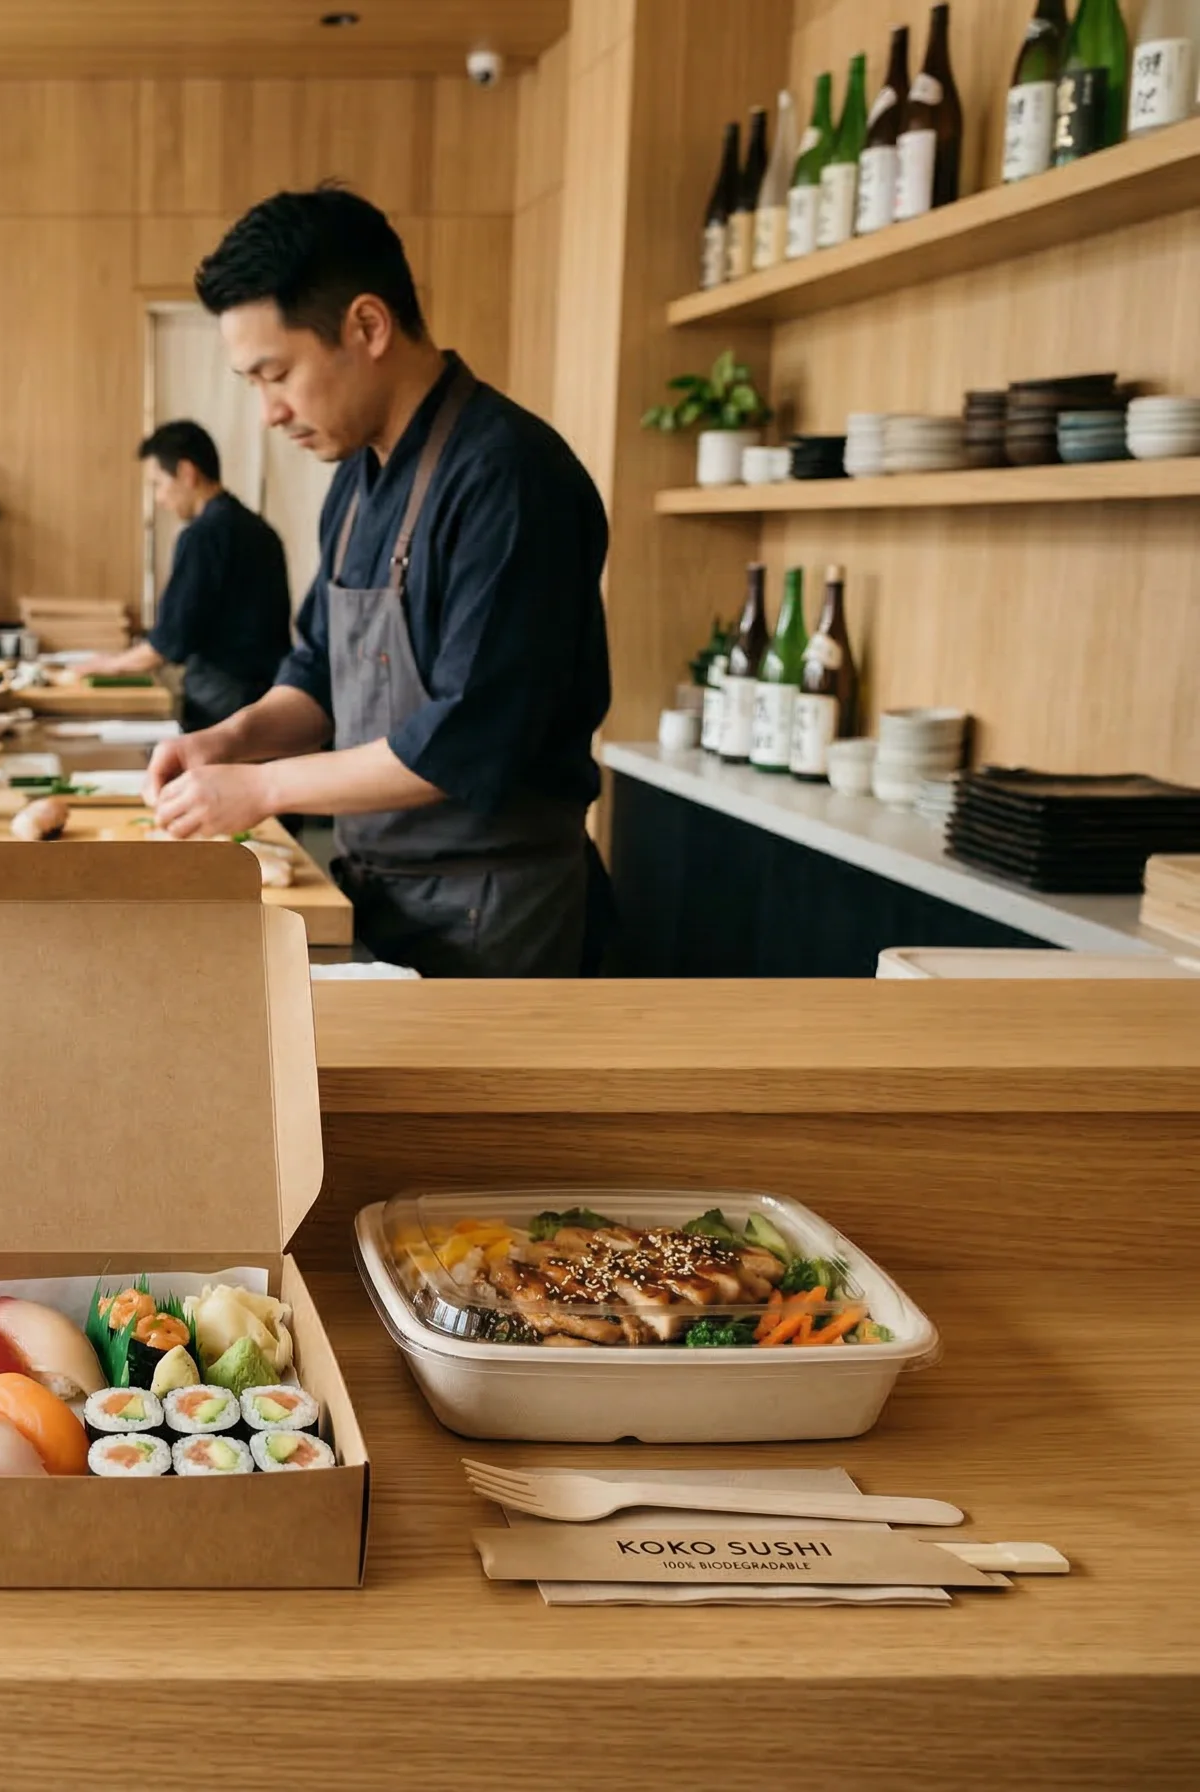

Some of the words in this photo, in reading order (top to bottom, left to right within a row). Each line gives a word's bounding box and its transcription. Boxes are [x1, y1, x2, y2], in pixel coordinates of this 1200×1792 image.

[616, 1540, 716, 1556] KOKO
[727, 1541, 833, 1557] SUSHI
[662, 1561, 696, 1570] 100%
[698, 1561, 812, 1571] BIODEGRADABLE
